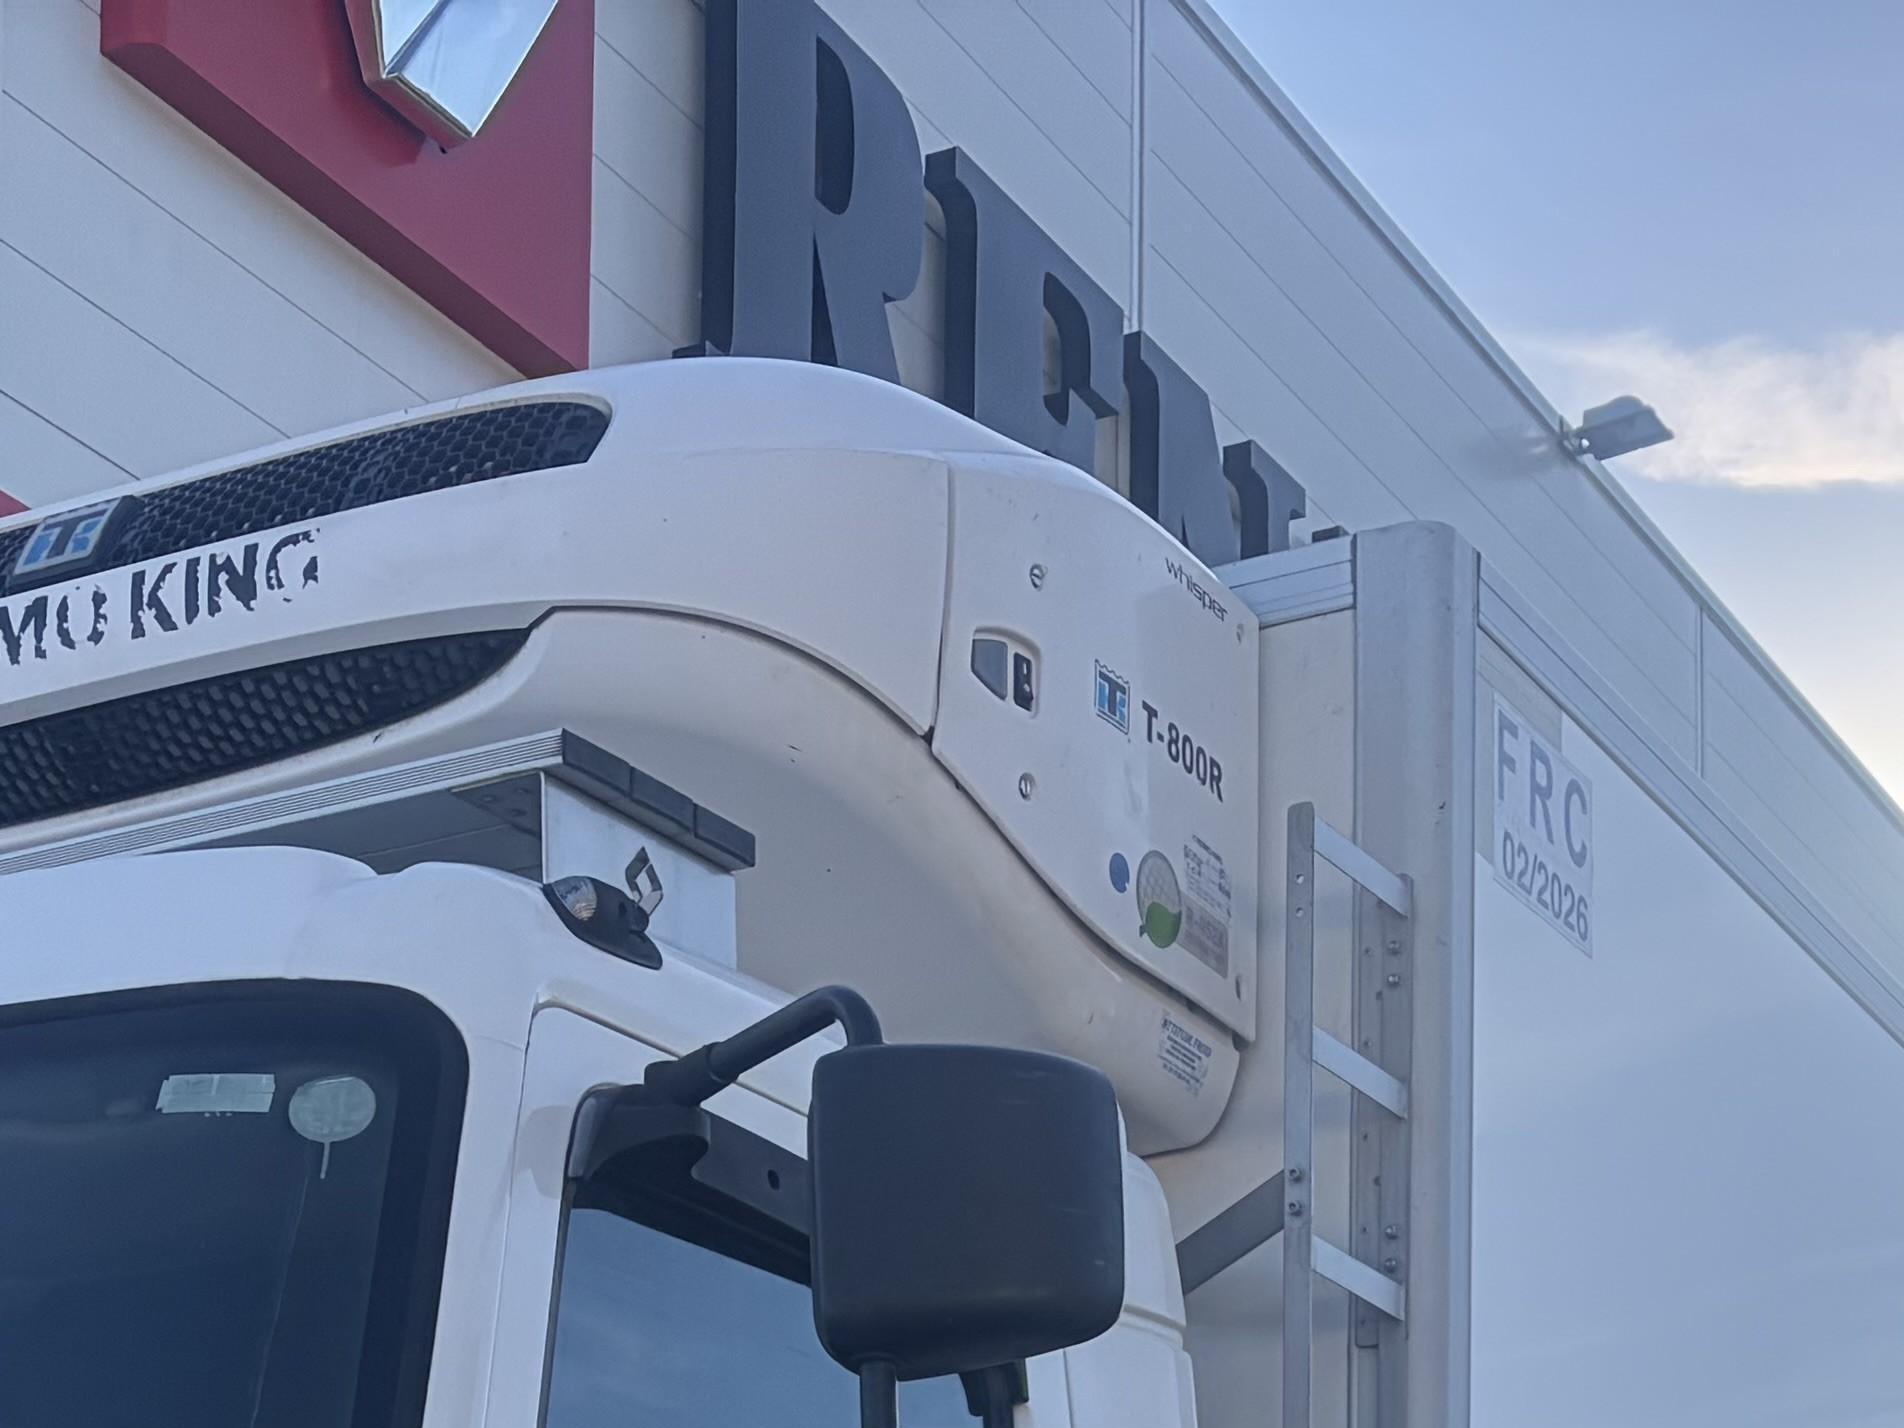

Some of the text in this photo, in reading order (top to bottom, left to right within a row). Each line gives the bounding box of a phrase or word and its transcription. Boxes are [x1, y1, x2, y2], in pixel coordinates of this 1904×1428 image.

[130, 527, 321, 640] KING
[1165, 557, 1229, 622] whisper
[1142, 699, 1224, 803] T-800R
[1497, 707, 1588, 869] FRC
[1502, 829, 1589, 943] 02/2026
